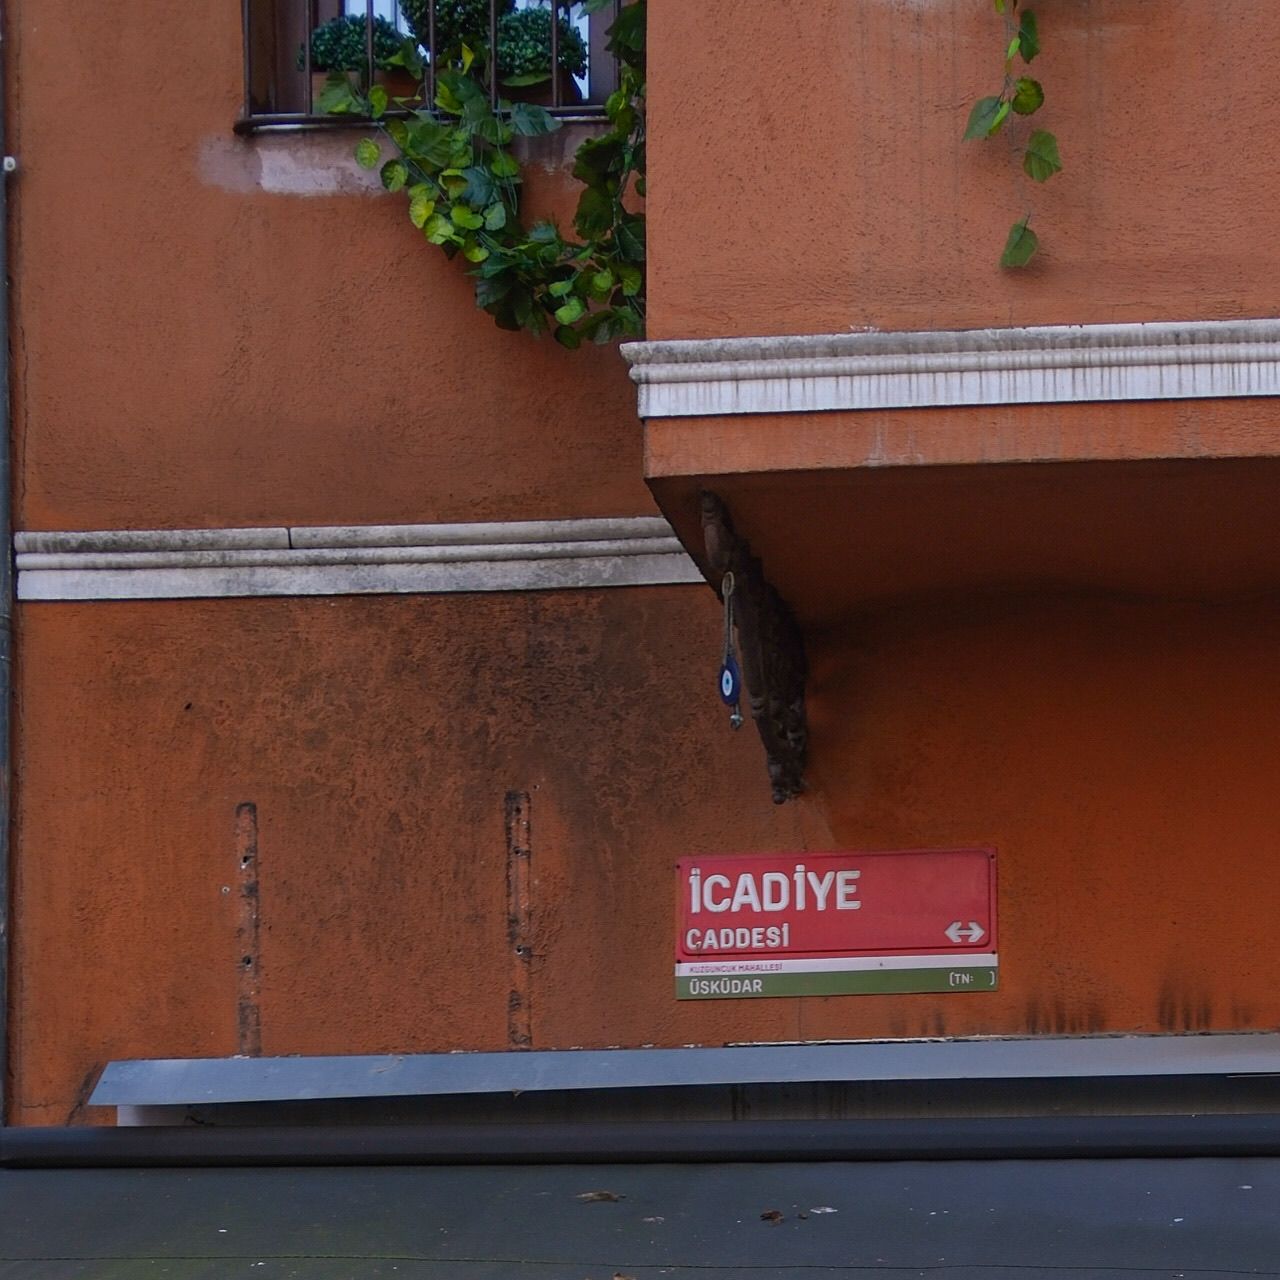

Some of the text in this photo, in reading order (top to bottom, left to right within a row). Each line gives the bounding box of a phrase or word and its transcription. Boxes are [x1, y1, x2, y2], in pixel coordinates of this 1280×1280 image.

[689, 864, 862, 914] İCADİYE
[686, 923, 789, 950] CADDESİ
[689, 977, 763, 995] ÜSKÜDAR
